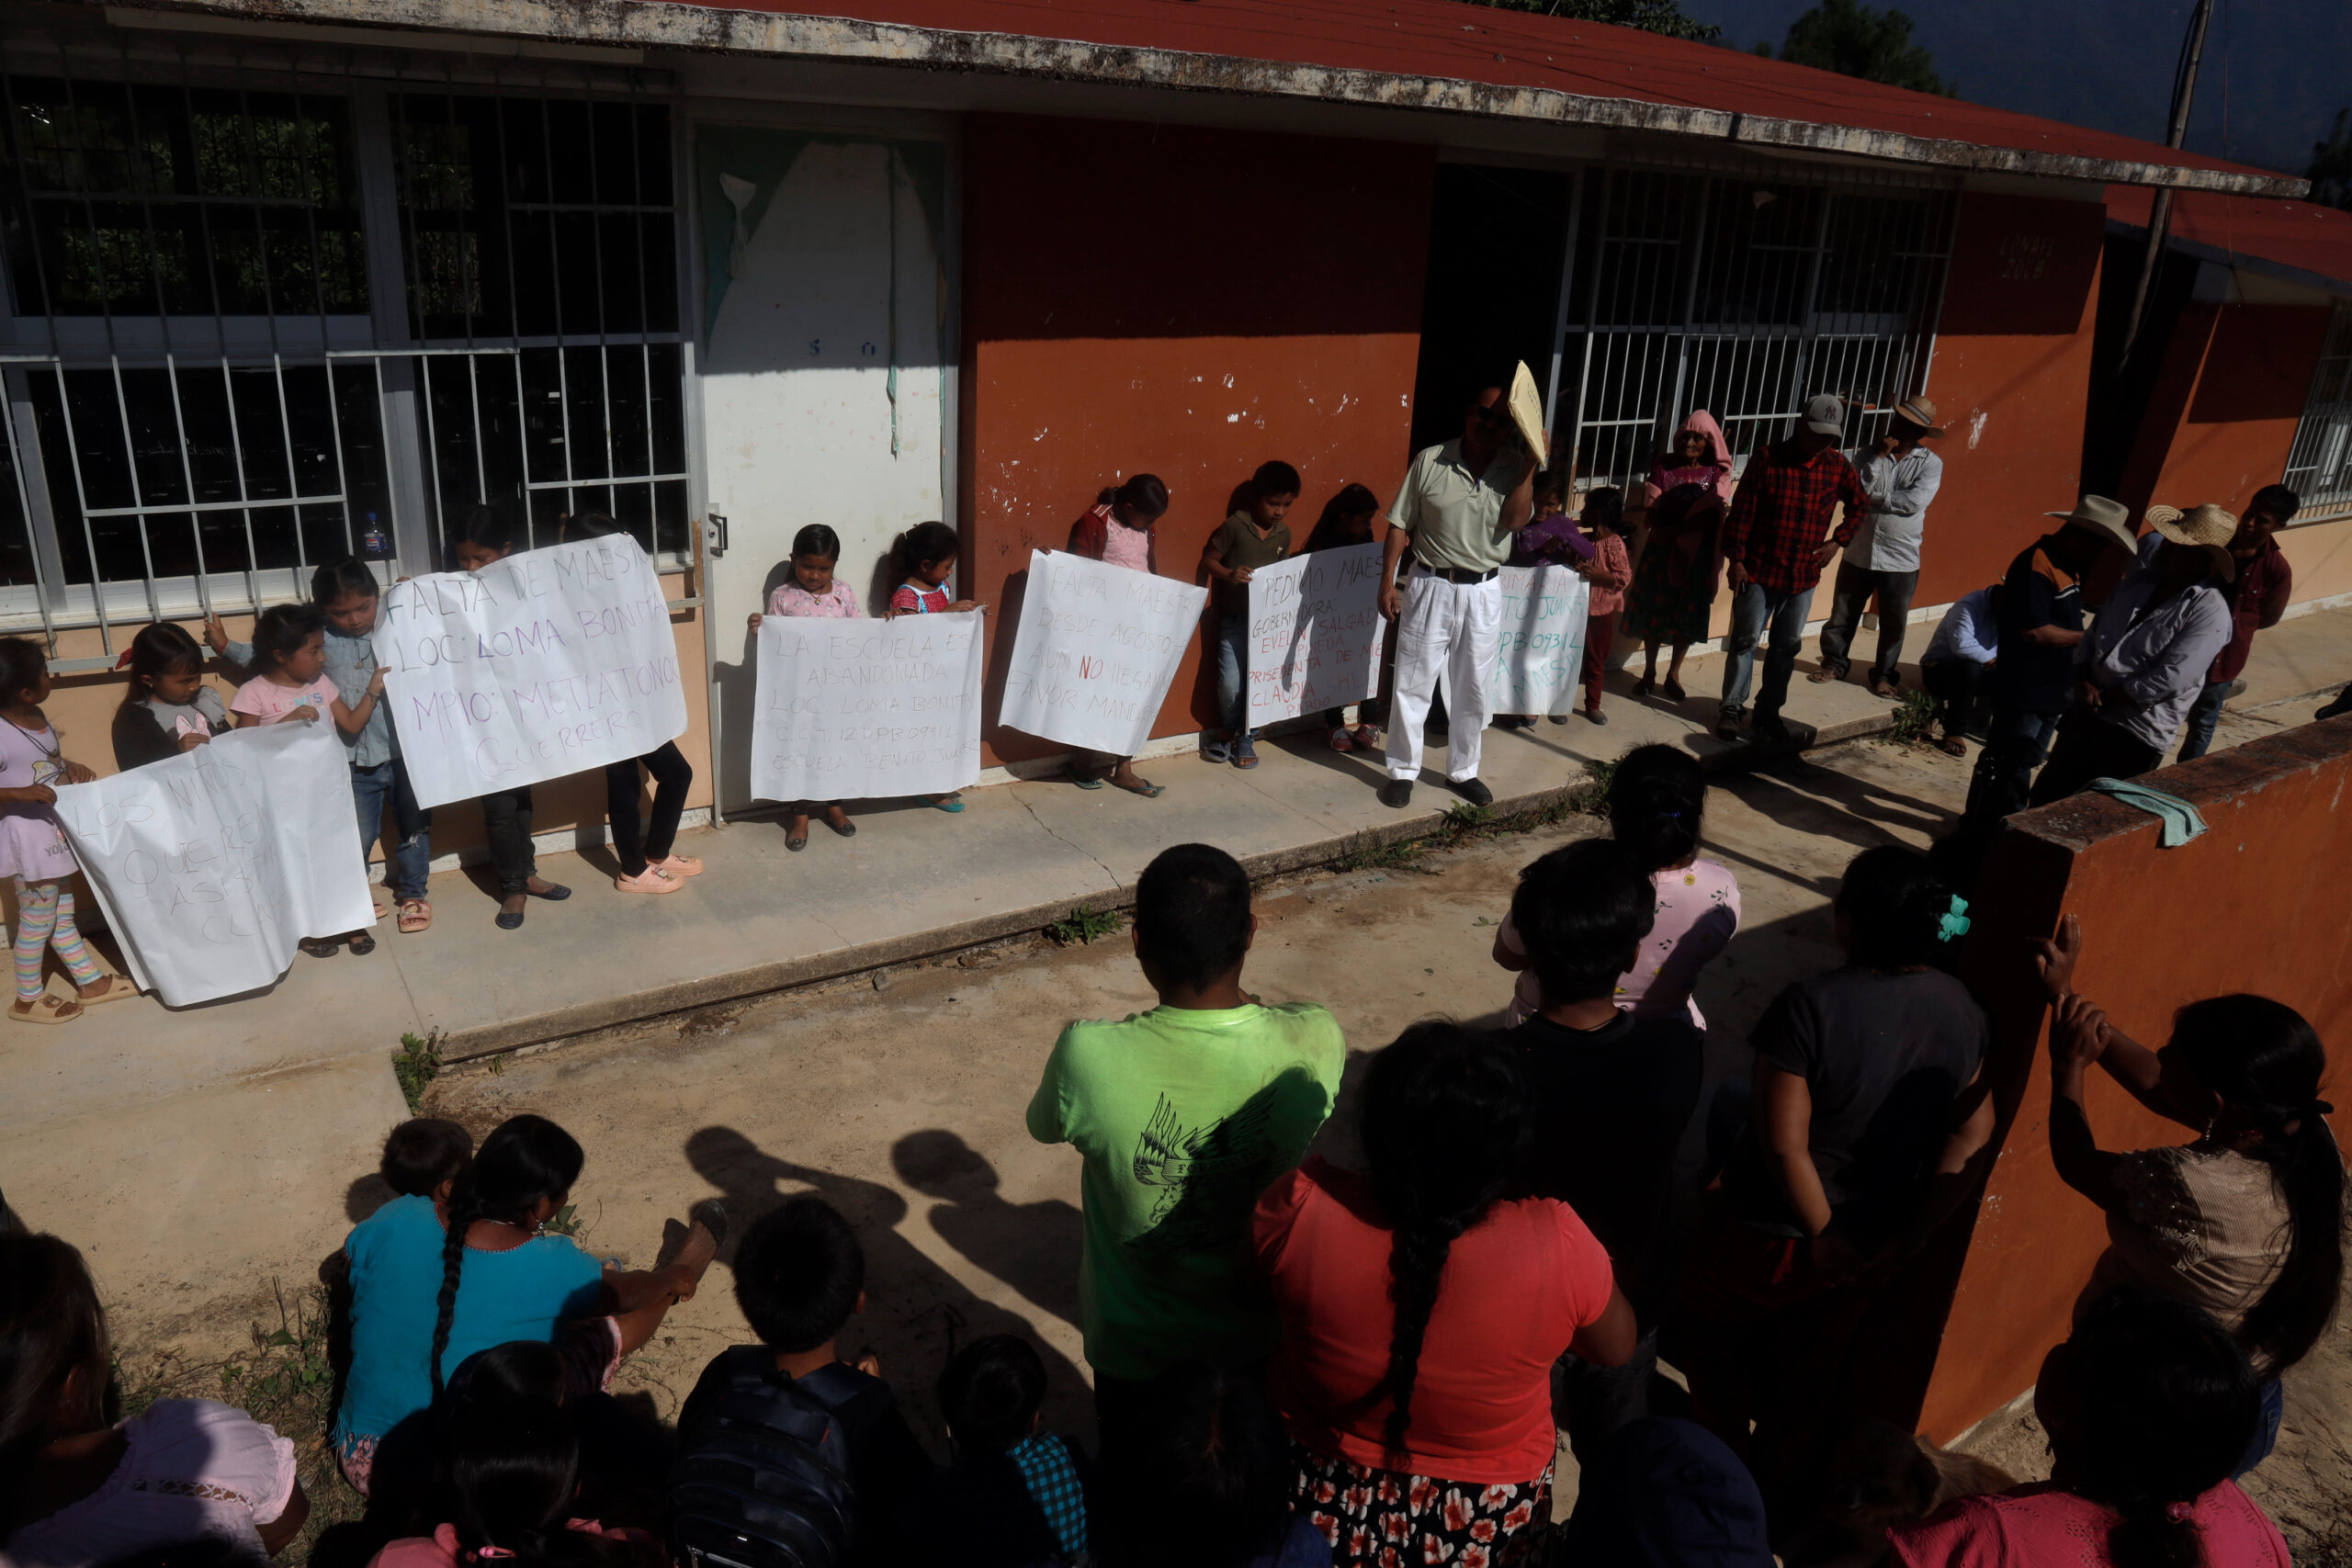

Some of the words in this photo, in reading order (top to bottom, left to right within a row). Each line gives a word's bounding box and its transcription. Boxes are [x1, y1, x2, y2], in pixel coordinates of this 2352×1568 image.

[386, 575, 499, 626] FALTA
[507, 559, 548, 602] DE
[1049, 566, 1108, 603] FALTA
[1125, 581, 1199, 619] MAESTRO
[1499, 570, 1567, 592] RIMARIA
[478, 618, 566, 660] LOMA
[576, 595, 668, 640] BONITA
[1037, 606, 1100, 637] DESDE
[1109, 623, 1171, 654] AGOSTO
[1261, 626, 1307, 654] EVELIN
[1317, 607, 1382, 636] SALGAD
[776, 632, 810, 659] LA
[830, 636, 933, 660] ESCUELA
[1028, 642, 1071, 671] AUN
[1079, 655, 1103, 680] NO
[1296, 634, 1345, 658] PINEDA
[1336, 649, 1353, 663] DE
[807, 662, 947, 686] ABANDONADA
[1005, 670, 1079, 710] FAVOR
[841, 697, 900, 715] LOMA
[910, 694, 971, 714] BONITA
[1251, 680, 1317, 707] CLAUDIA
[1286, 695, 1331, 718] PARDO
[474, 709, 641, 778] GUERRERO
[773, 755, 846, 772] ESCUELA
[74, 794, 154, 838] LOS
